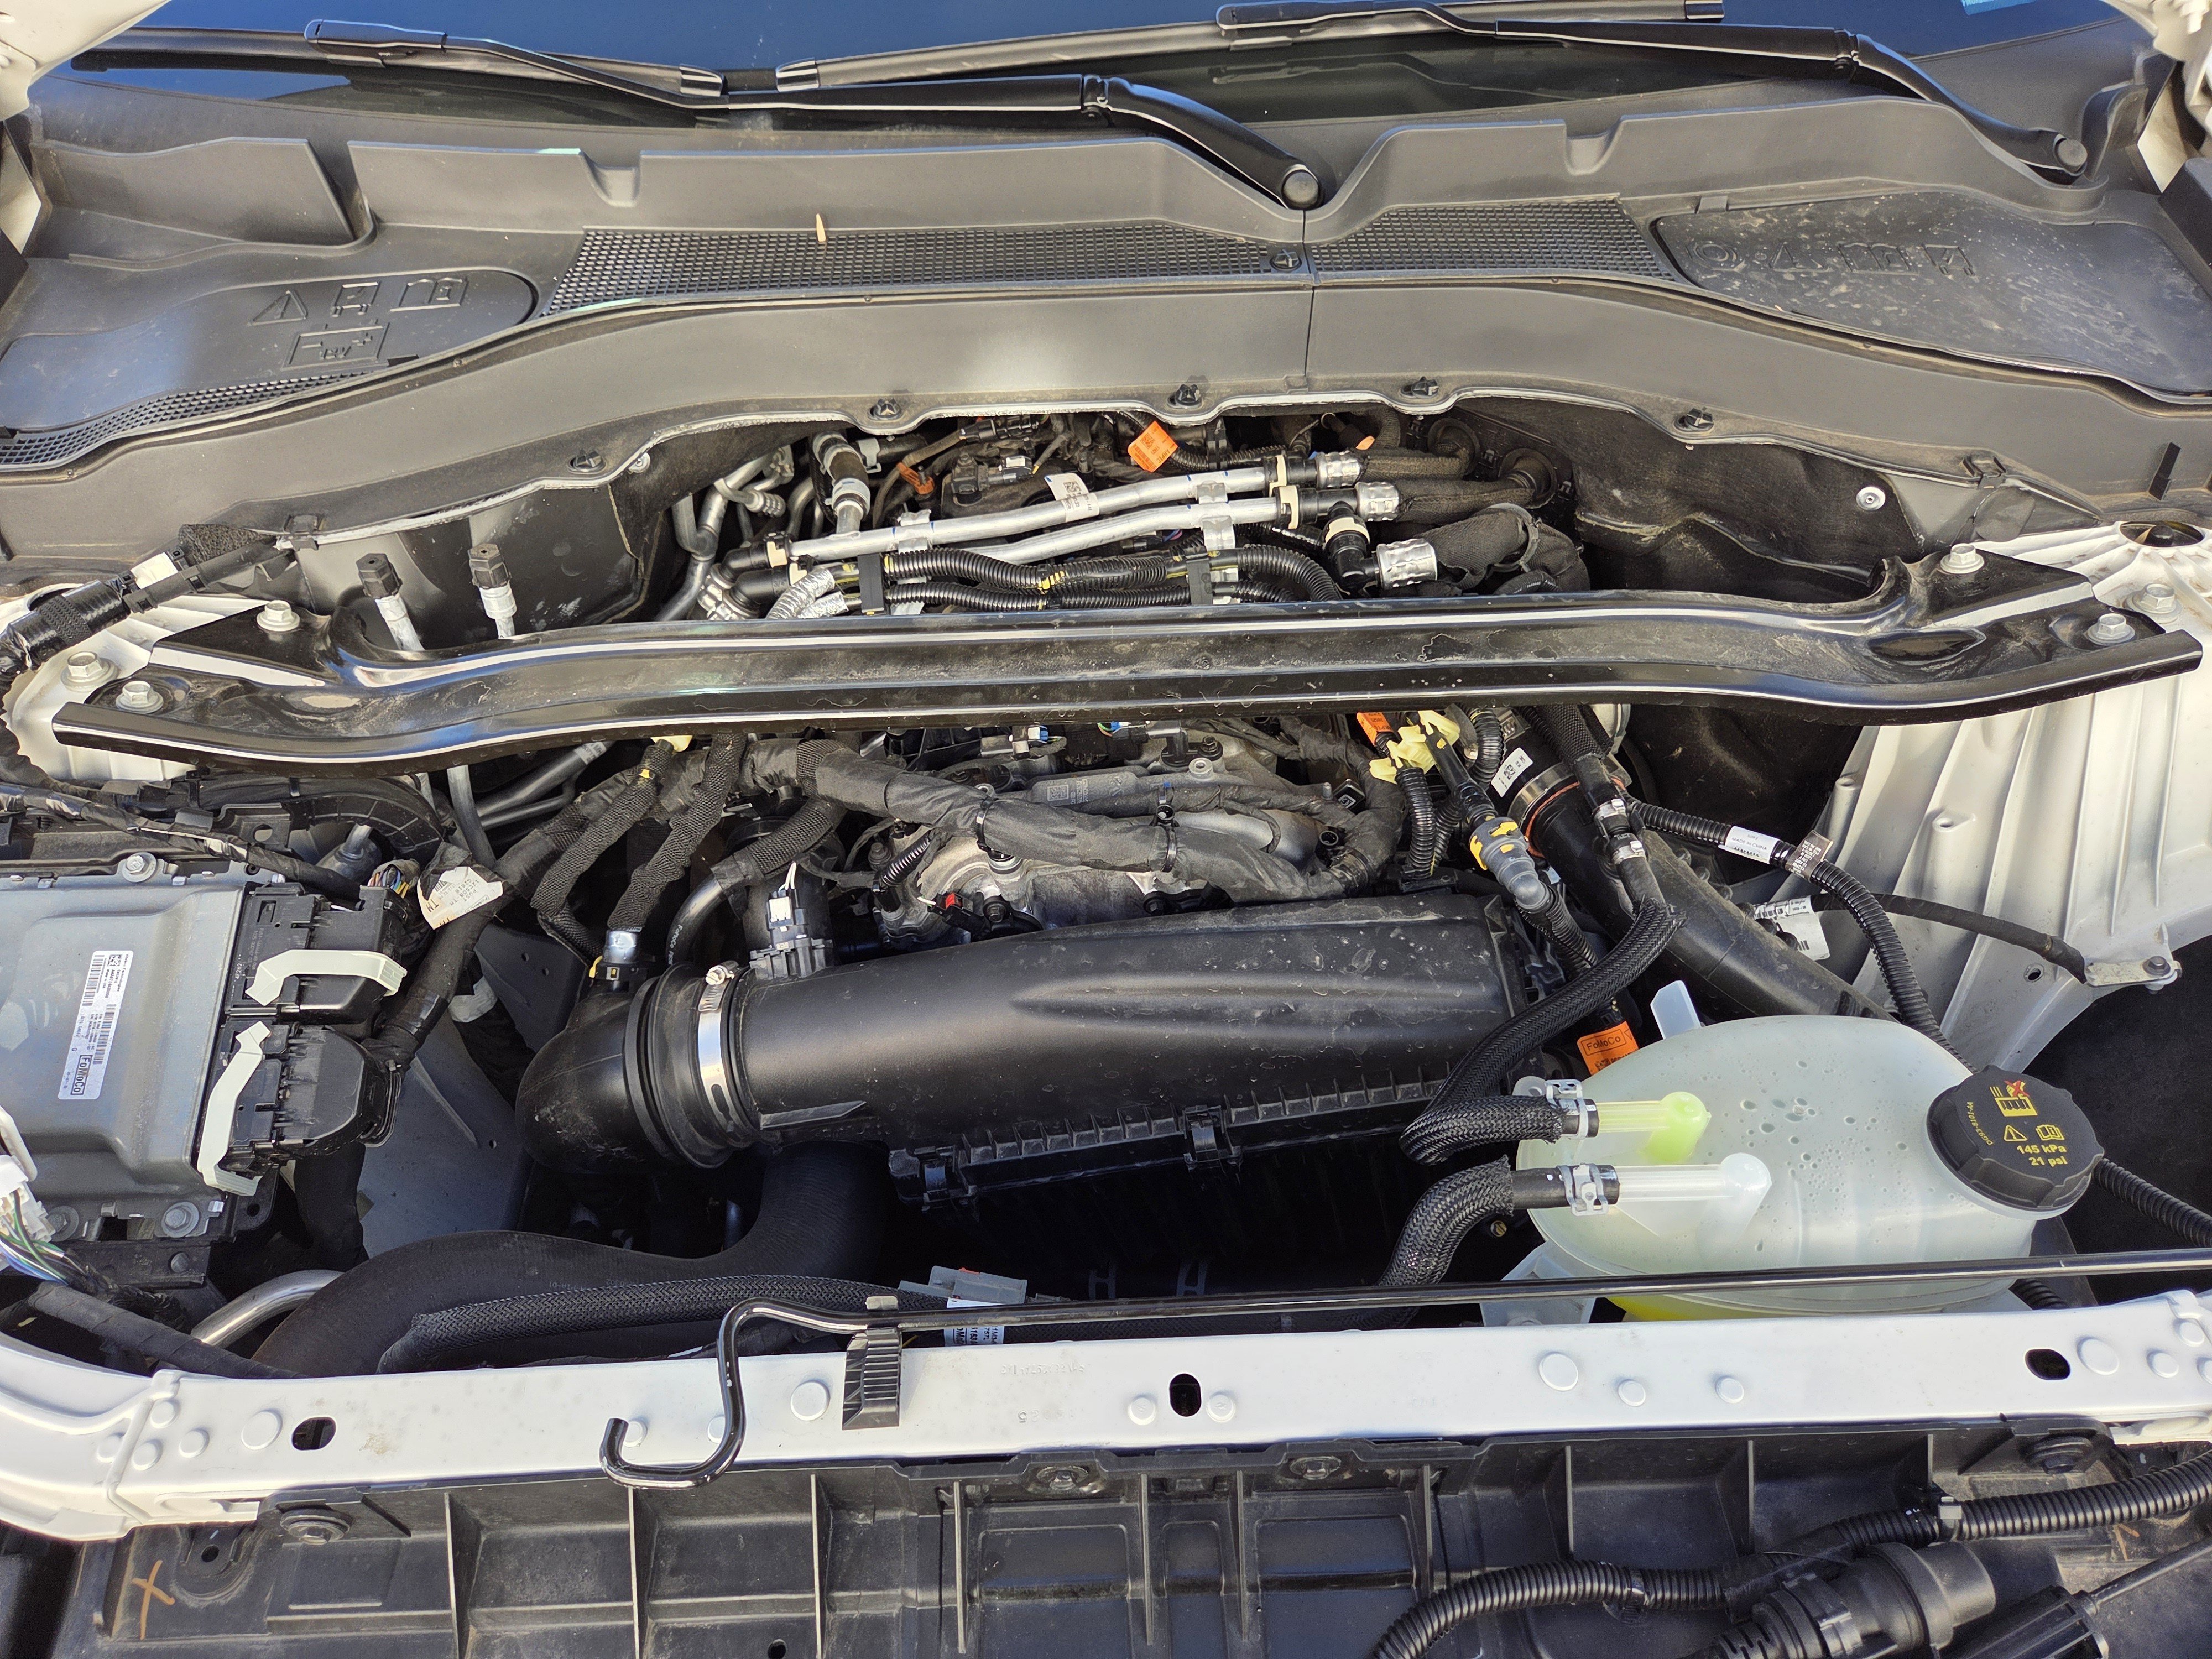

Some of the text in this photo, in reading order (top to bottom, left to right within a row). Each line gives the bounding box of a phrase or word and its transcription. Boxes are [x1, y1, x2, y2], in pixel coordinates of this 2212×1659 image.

[424, 898, 440, 912] TM
[1586, 1035, 1621, 1051] FoMoCo
[72, 1057, 90, 1092] FoMoCo
[2016, 1144, 2067, 1154] 145 kPa
[2029, 1156, 2067, 1168] 21 psi
